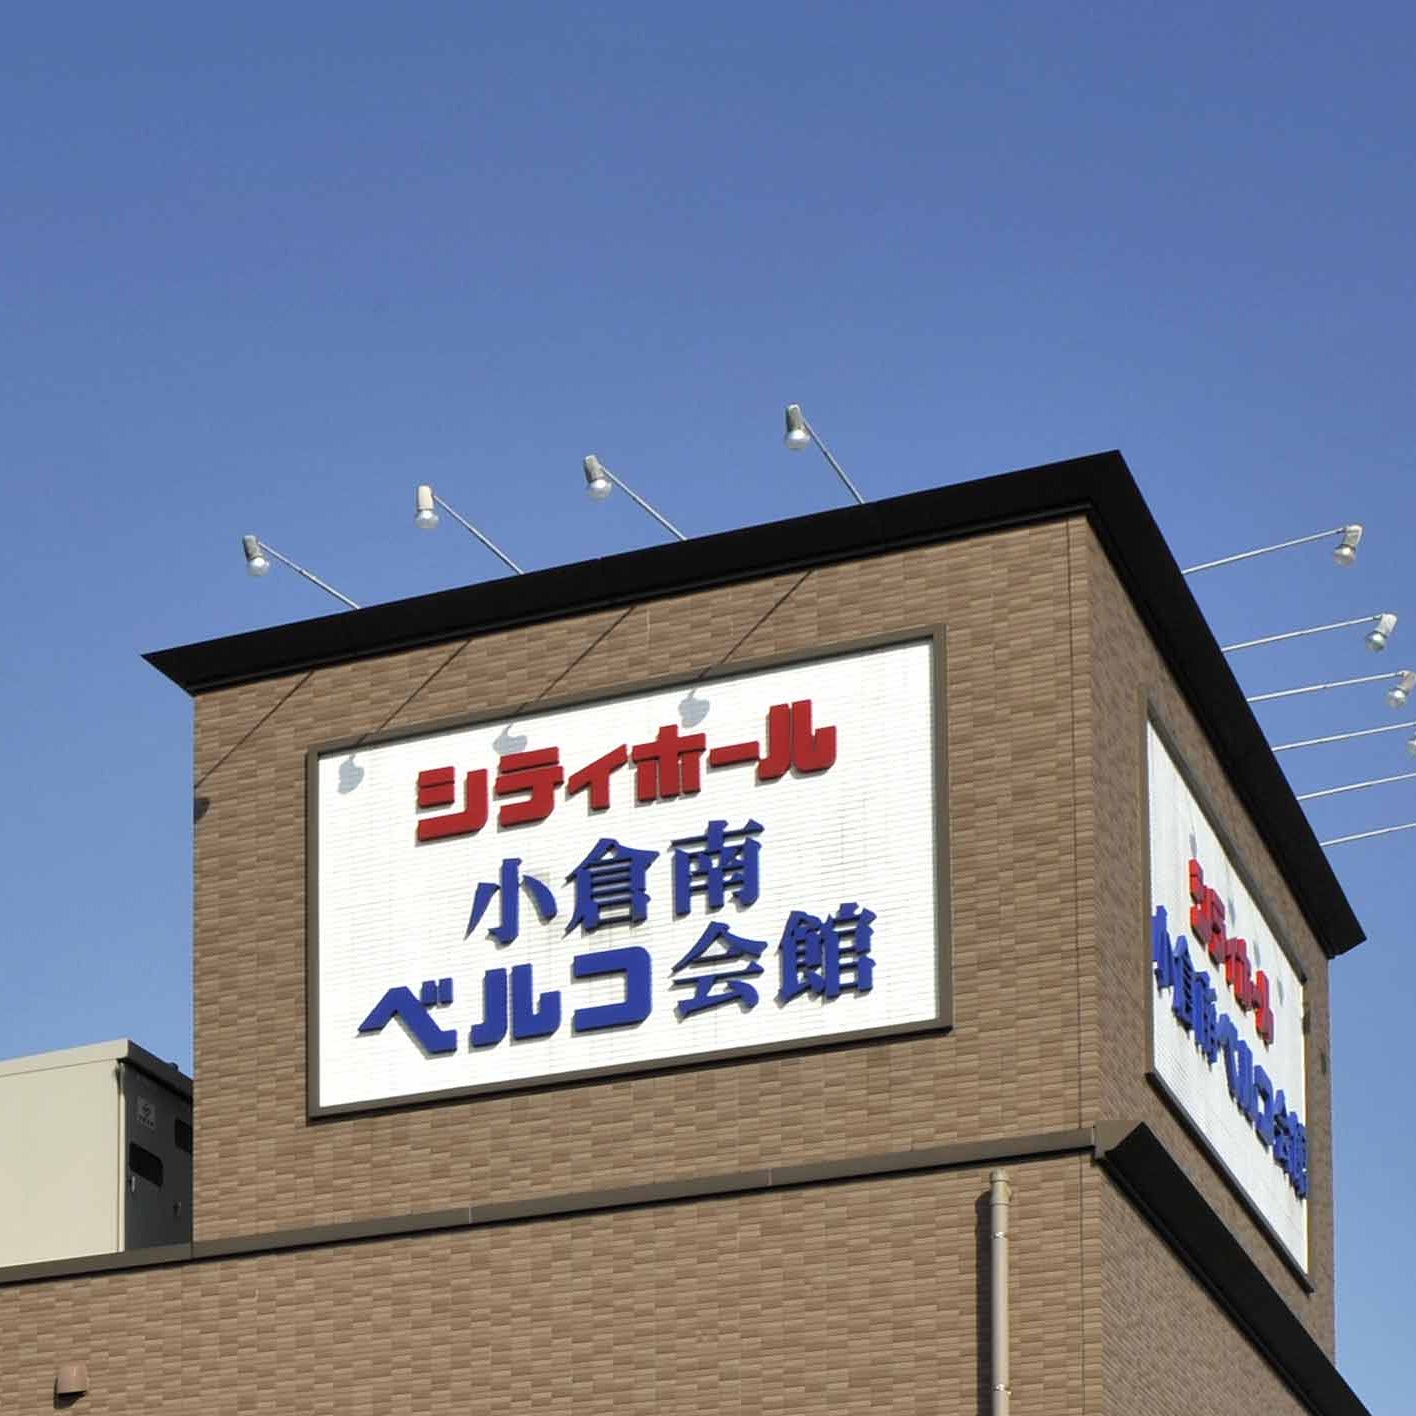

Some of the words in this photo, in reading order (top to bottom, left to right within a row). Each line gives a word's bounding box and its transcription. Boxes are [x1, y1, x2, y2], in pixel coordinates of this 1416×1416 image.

[417, 699, 837, 841] シティホール
[465, 818, 764, 945] 小倉南
[358, 902, 877, 1054] ベルコ会館
